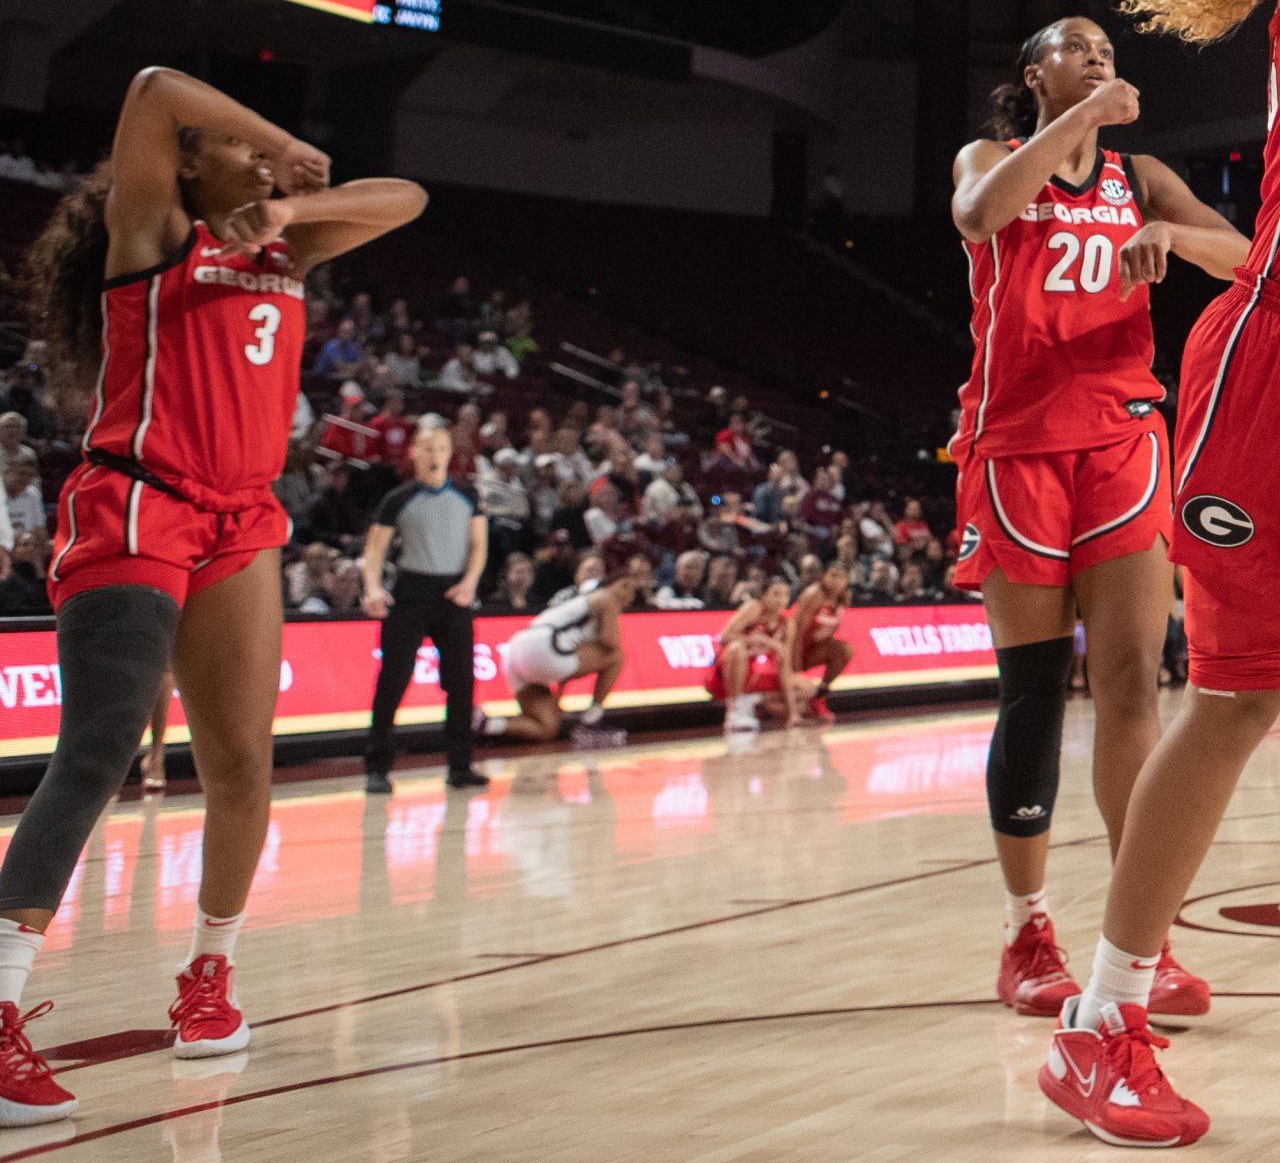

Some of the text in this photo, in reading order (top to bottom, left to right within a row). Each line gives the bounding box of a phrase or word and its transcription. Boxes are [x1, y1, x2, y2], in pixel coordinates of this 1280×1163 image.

[1019, 203, 1138, 227] GEORGIA
[1043, 231, 1113, 294] 20
[244, 303, 282, 365] 3
[870, 626, 942, 656] WELLS
